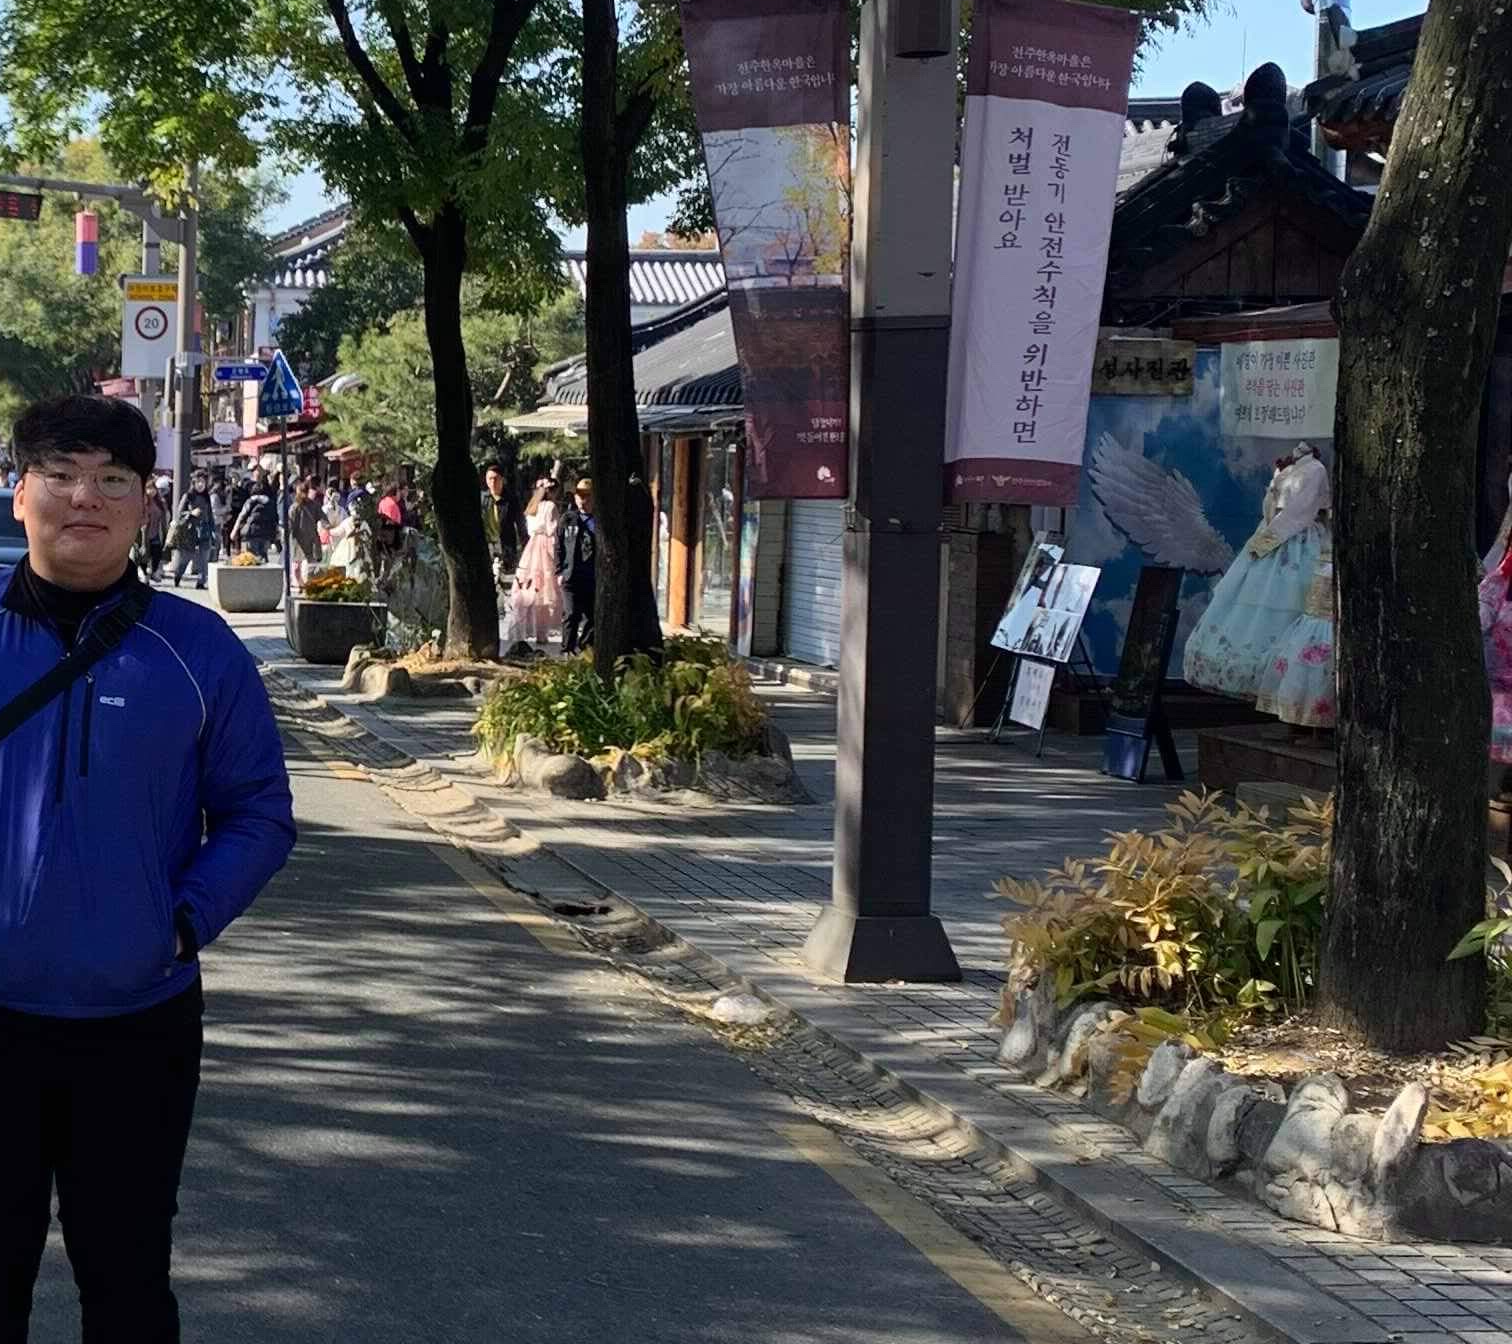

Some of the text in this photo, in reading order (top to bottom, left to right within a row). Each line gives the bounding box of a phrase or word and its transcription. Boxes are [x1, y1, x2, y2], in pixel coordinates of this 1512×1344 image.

[1010, 45, 1093, 69] 전주한옥마을은
[1010, 64, 1056, 82] 아름다운
[740, 76, 787, 92] 아름다운
[993, 127, 1034, 249] 처벌 받아요
[1048, 133, 1072, 204] 전동기
[1028, 212, 1066, 335] 안전수칙을
[143, 317, 160, 329] 20
[1013, 343, 1048, 444] 위반하면
